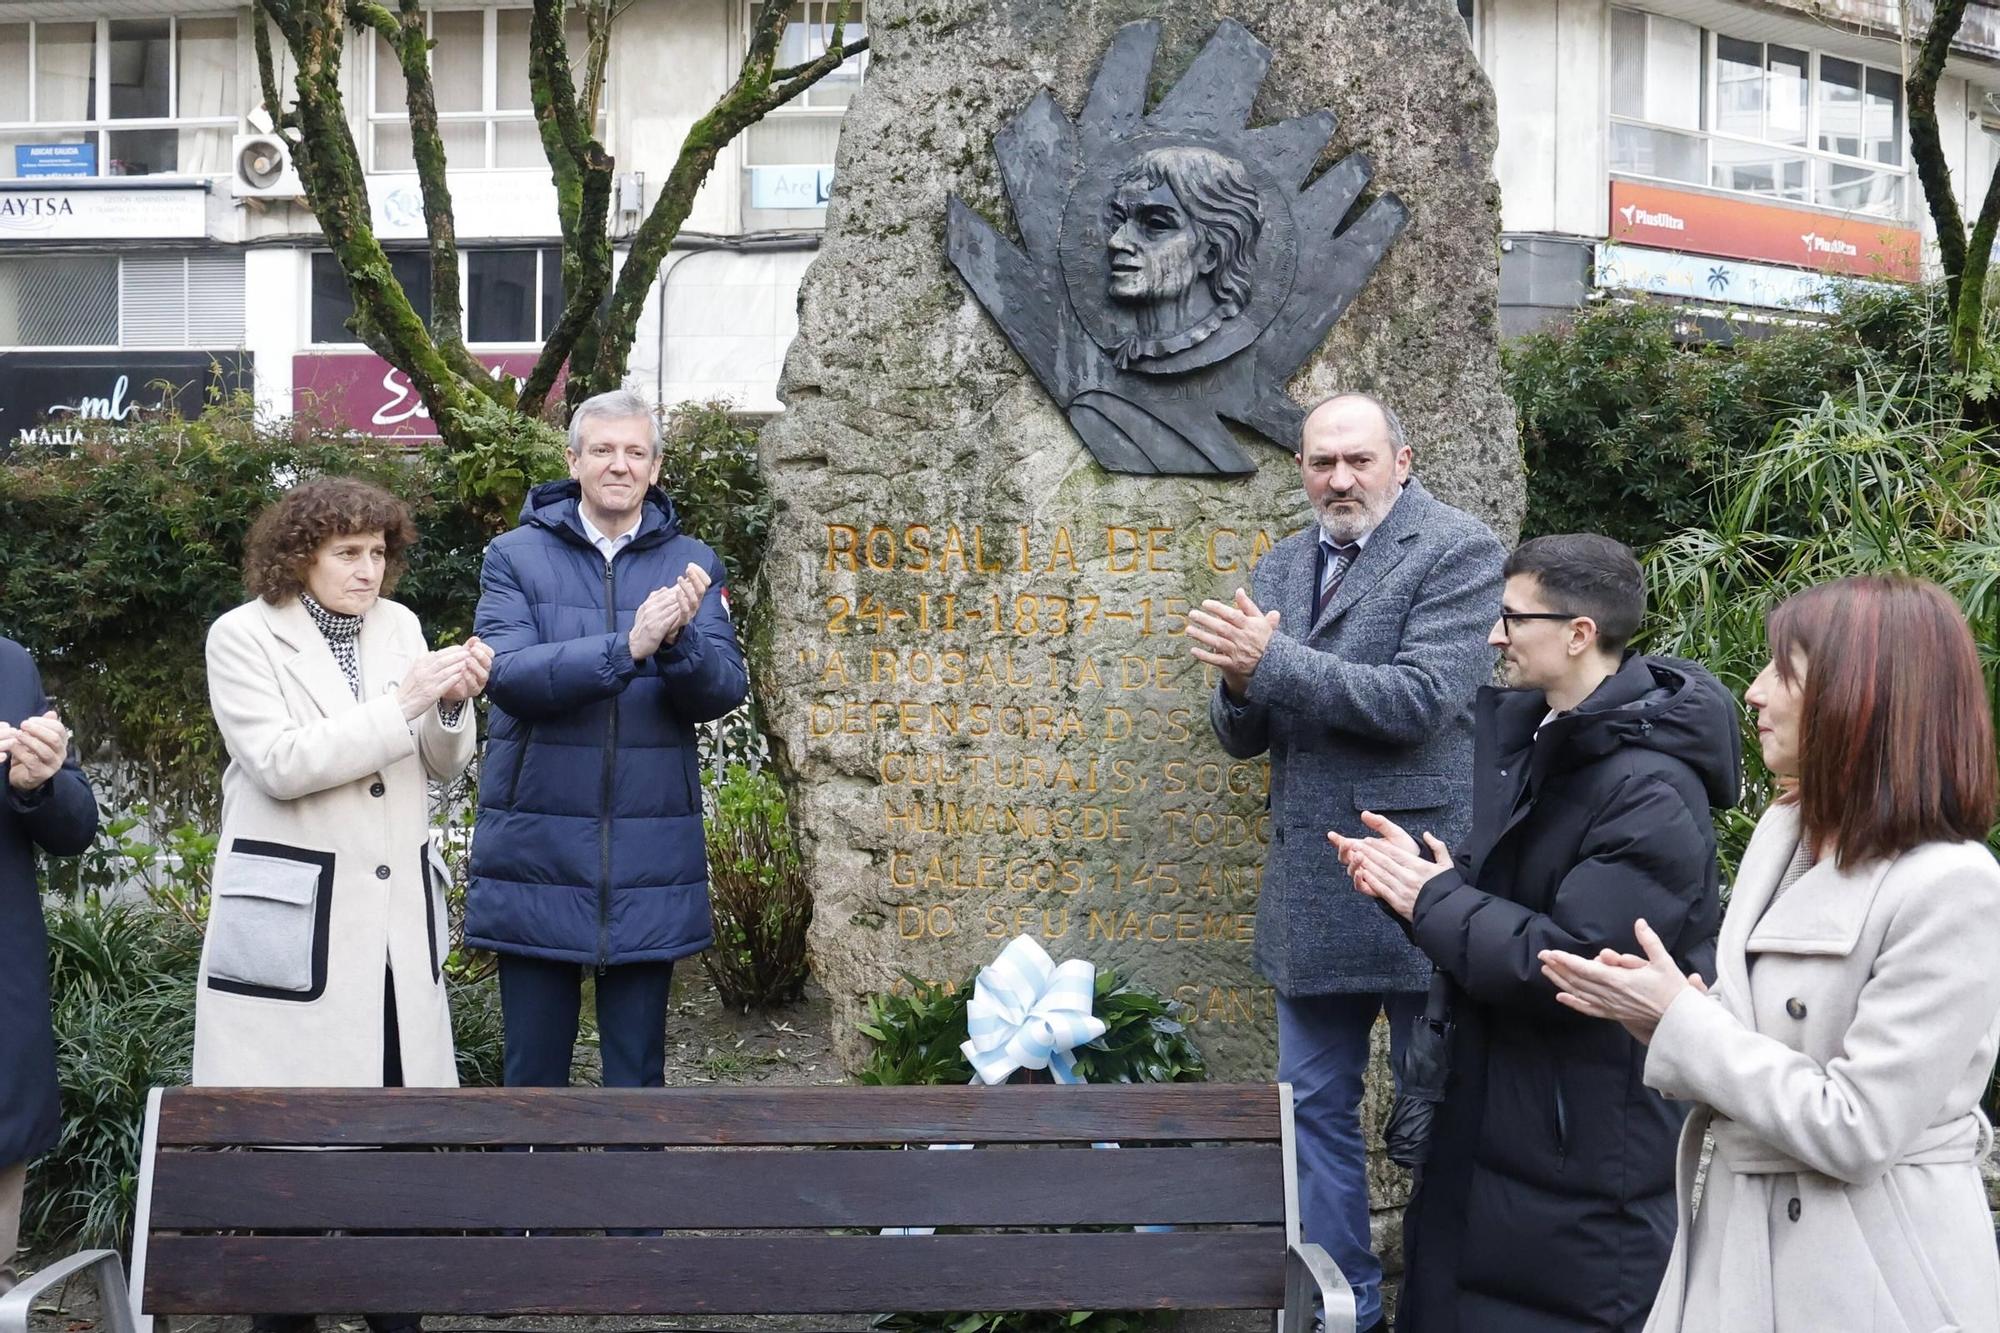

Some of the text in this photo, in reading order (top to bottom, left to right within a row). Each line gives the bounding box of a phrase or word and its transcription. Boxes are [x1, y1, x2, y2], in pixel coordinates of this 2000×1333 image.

[0, 197, 73, 216] AYTSA
[1636, 209, 1684, 230] PlusUltra
[825, 522, 1303, 573] ROSALIA DE CA
[1121, 655, 1184, 690] DE
[809, 700, 1190, 742] DEFENSORA DOS
[1107, 862, 1181, 896] 145
[899, 904, 953, 940] DO
